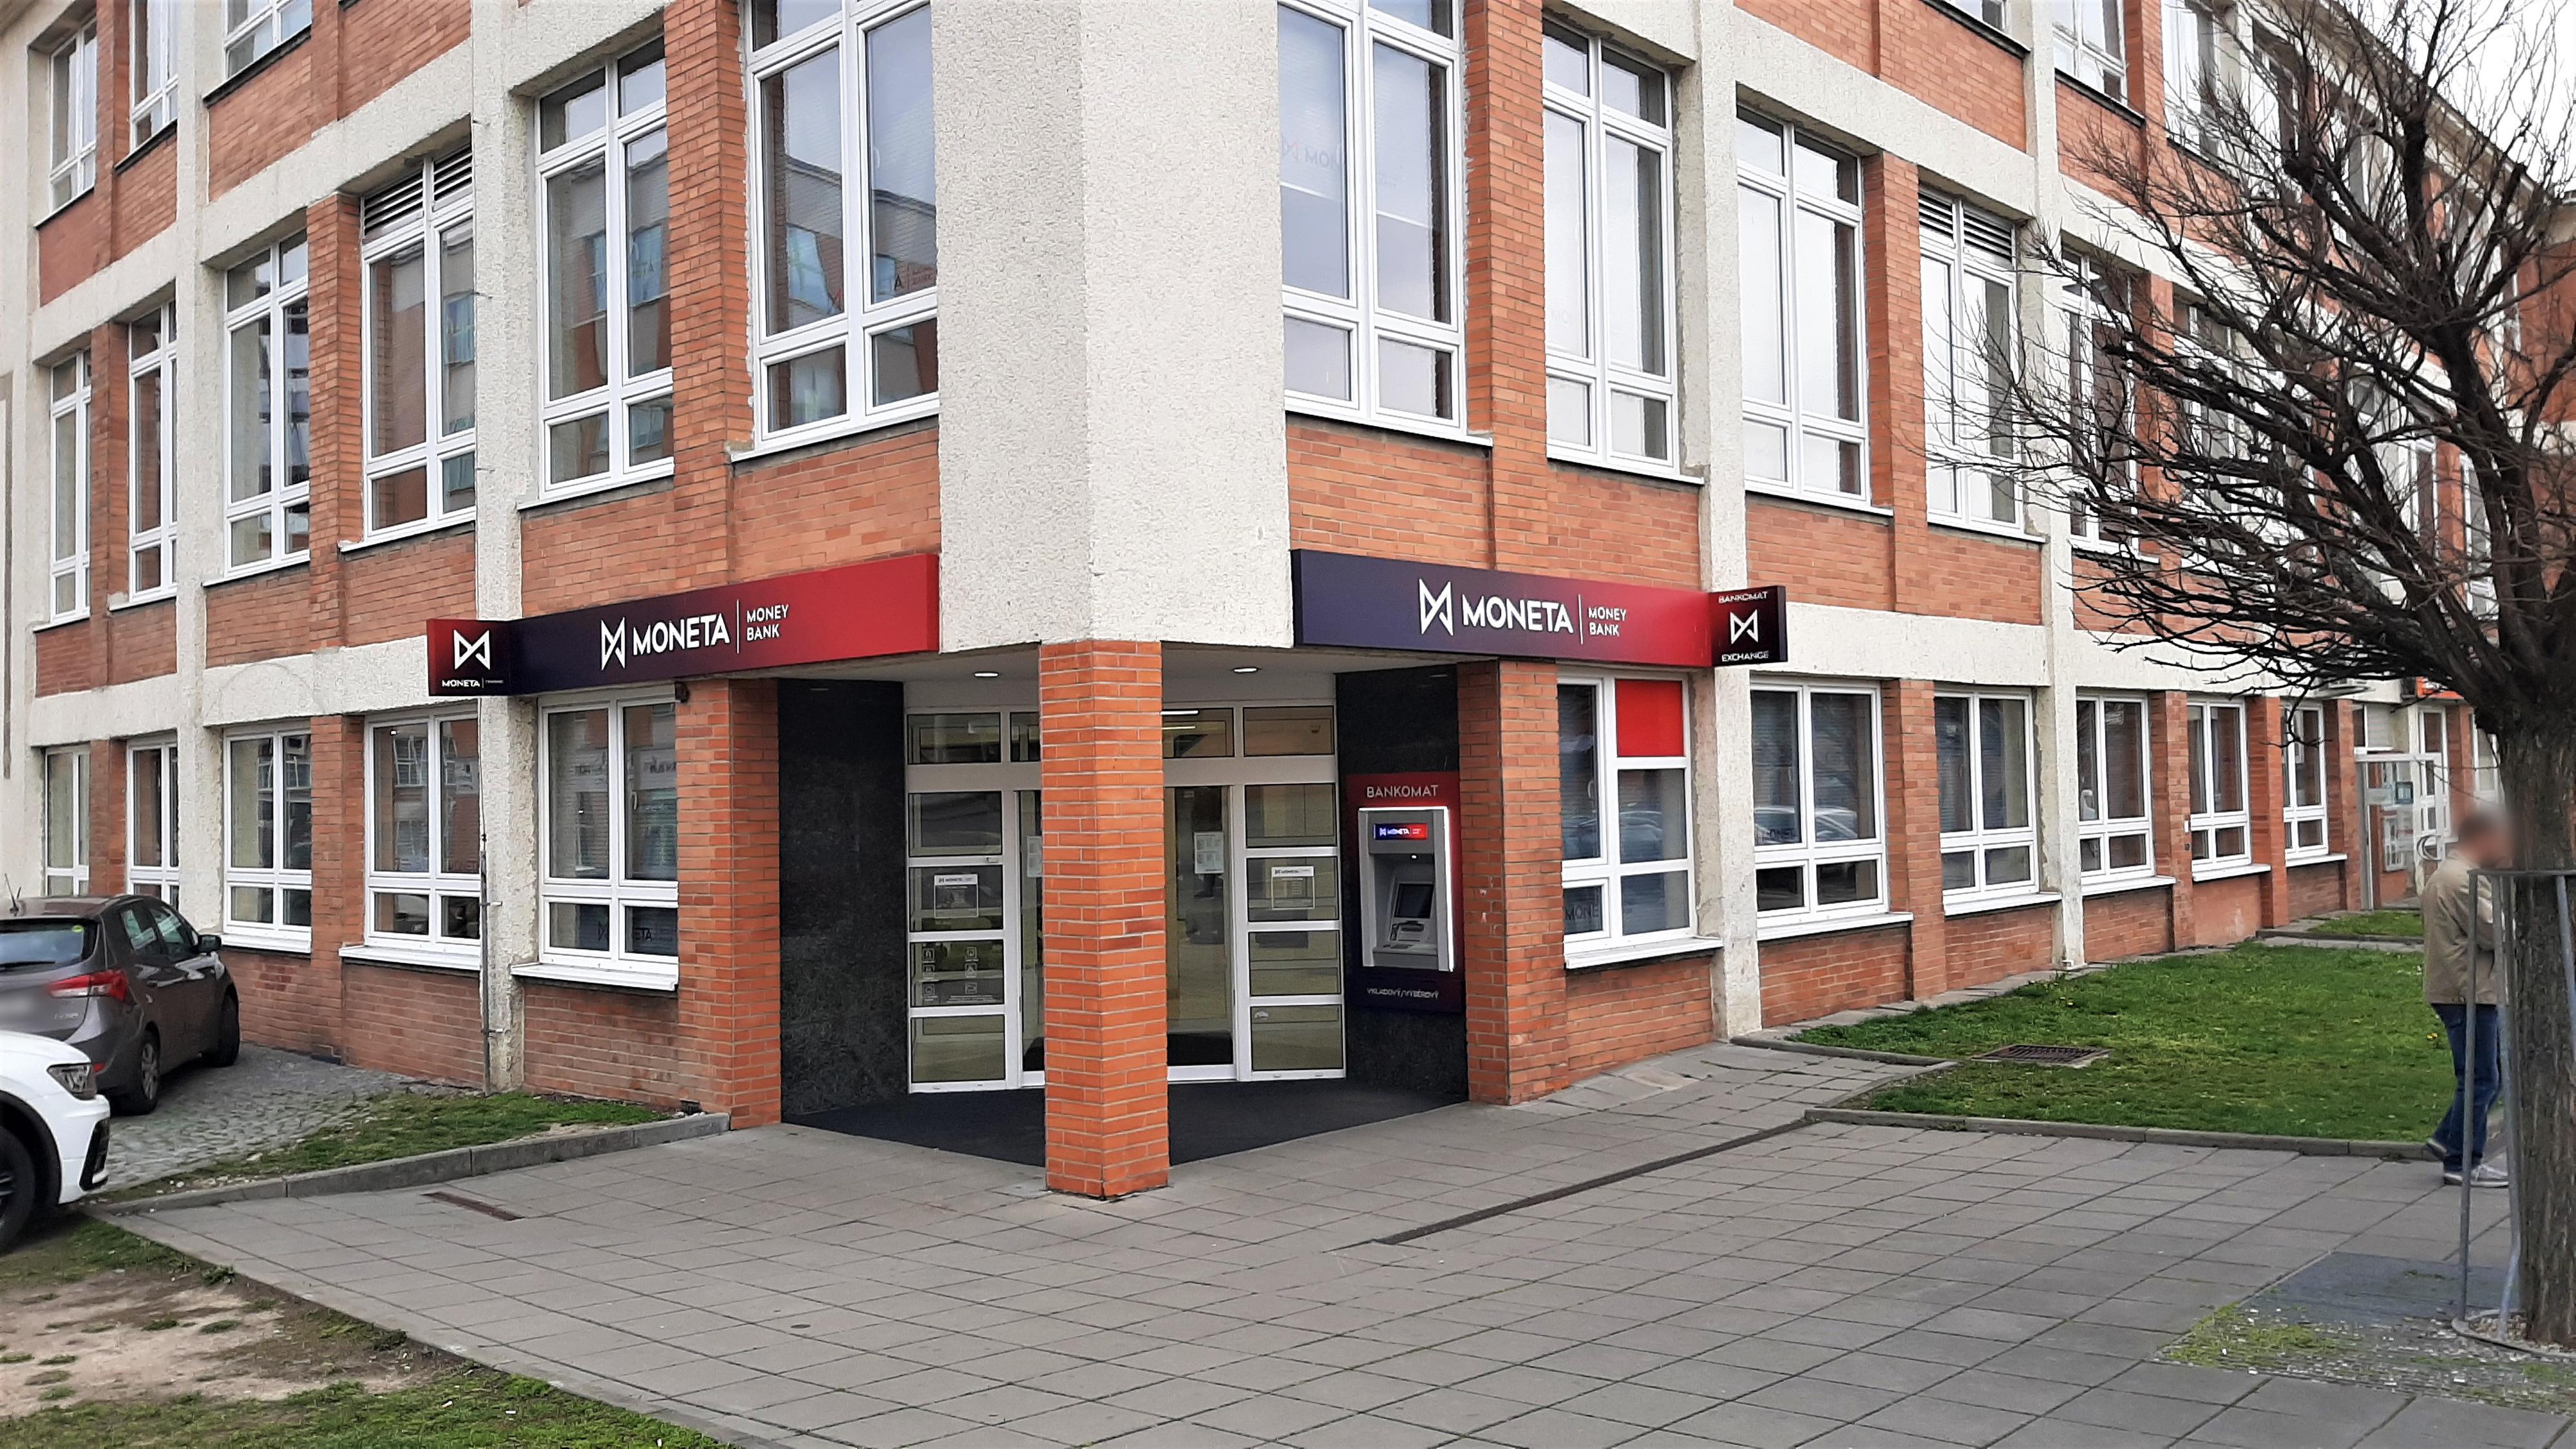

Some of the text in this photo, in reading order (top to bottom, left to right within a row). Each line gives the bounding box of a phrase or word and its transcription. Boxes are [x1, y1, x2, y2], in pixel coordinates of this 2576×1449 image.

[1718, 591, 1768, 603] BANKOMAT
[746, 604, 789, 623] MONEY
[1462, 594, 1574, 634] MONETA
[1588, 606, 1627, 621] MONEY
[633, 612, 730, 656] MONETA
[746, 623, 780, 641] BANK
[1589, 622, 1620, 636] BANK
[1721, 650, 1769, 662] EXCHANGE
[1367, 784, 1439, 798] BANKOMAT
